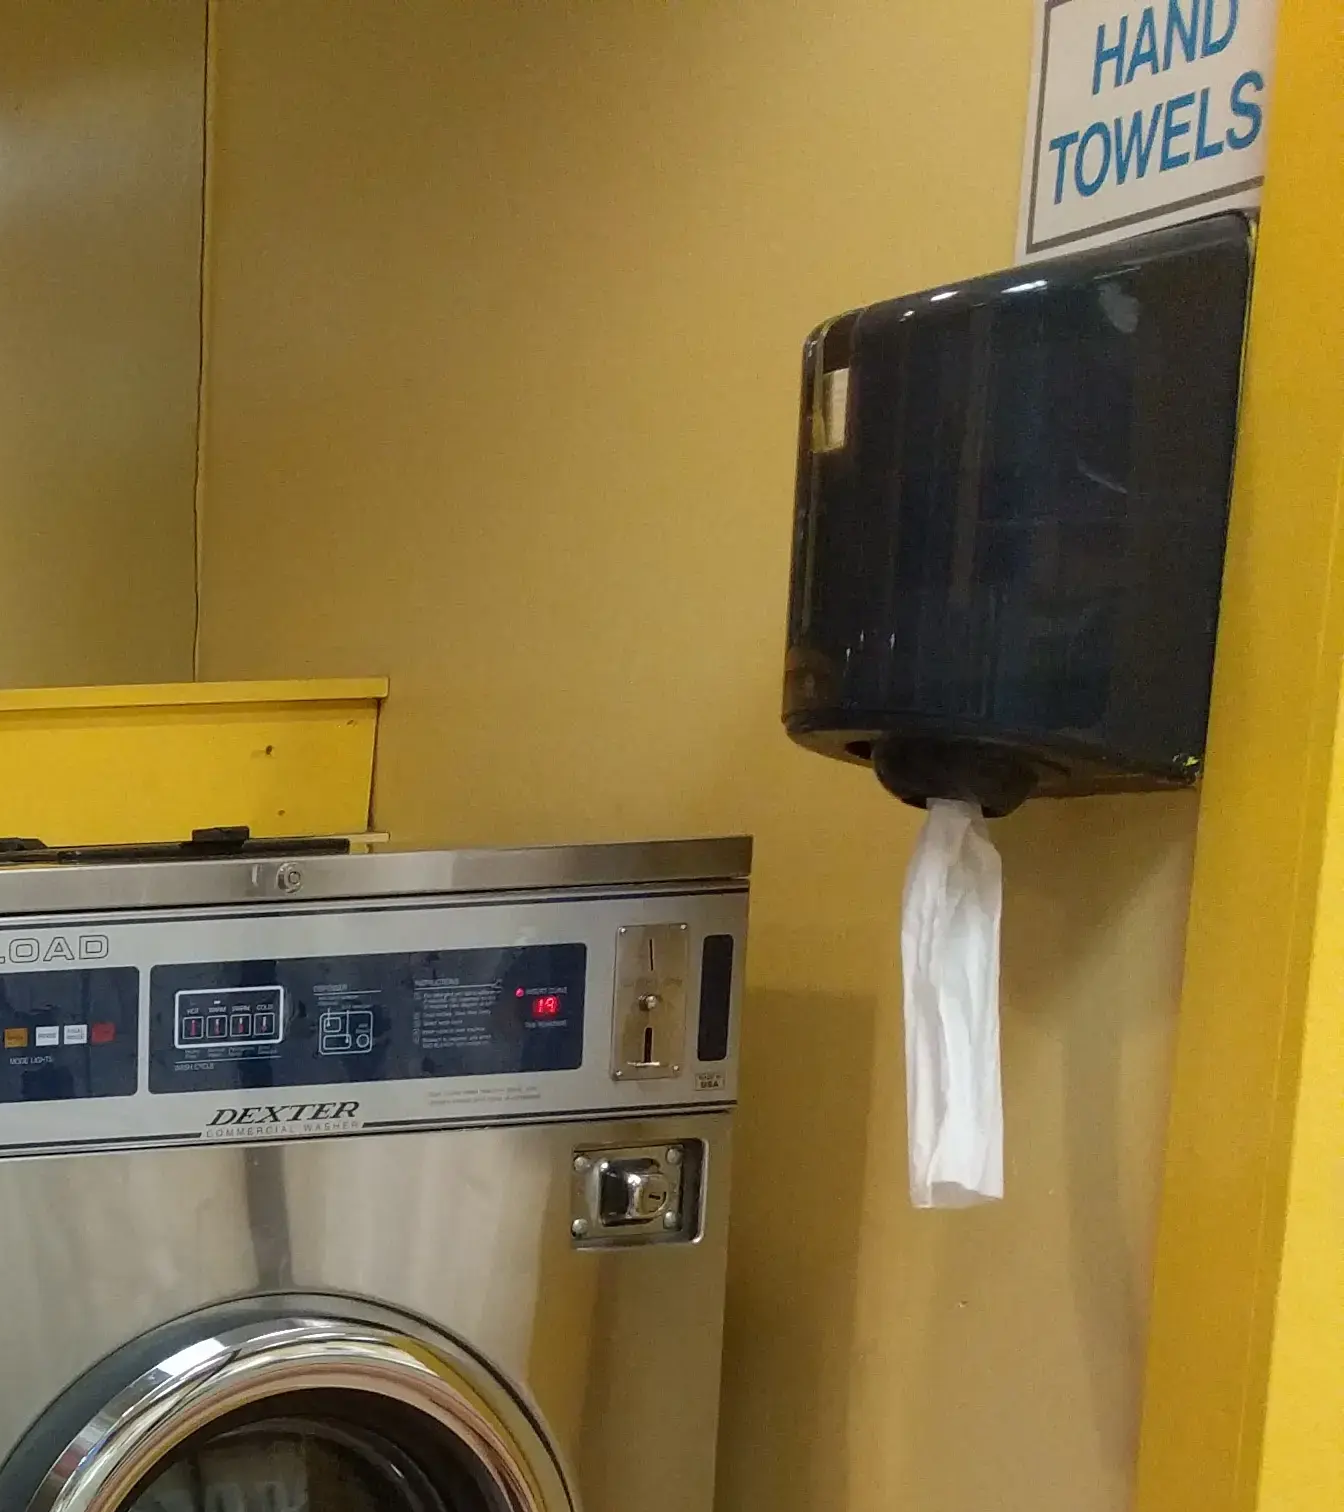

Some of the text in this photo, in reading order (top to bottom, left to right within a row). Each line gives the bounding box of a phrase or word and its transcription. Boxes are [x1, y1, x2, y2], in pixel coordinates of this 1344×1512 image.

[1092, 0, 1239, 95] HAND
[1048, 70, 1264, 205] TOWELS
[205, 1101, 360, 1127] DEXTER
[206, 1121, 359, 1138] COMMERCIAL WASHER
